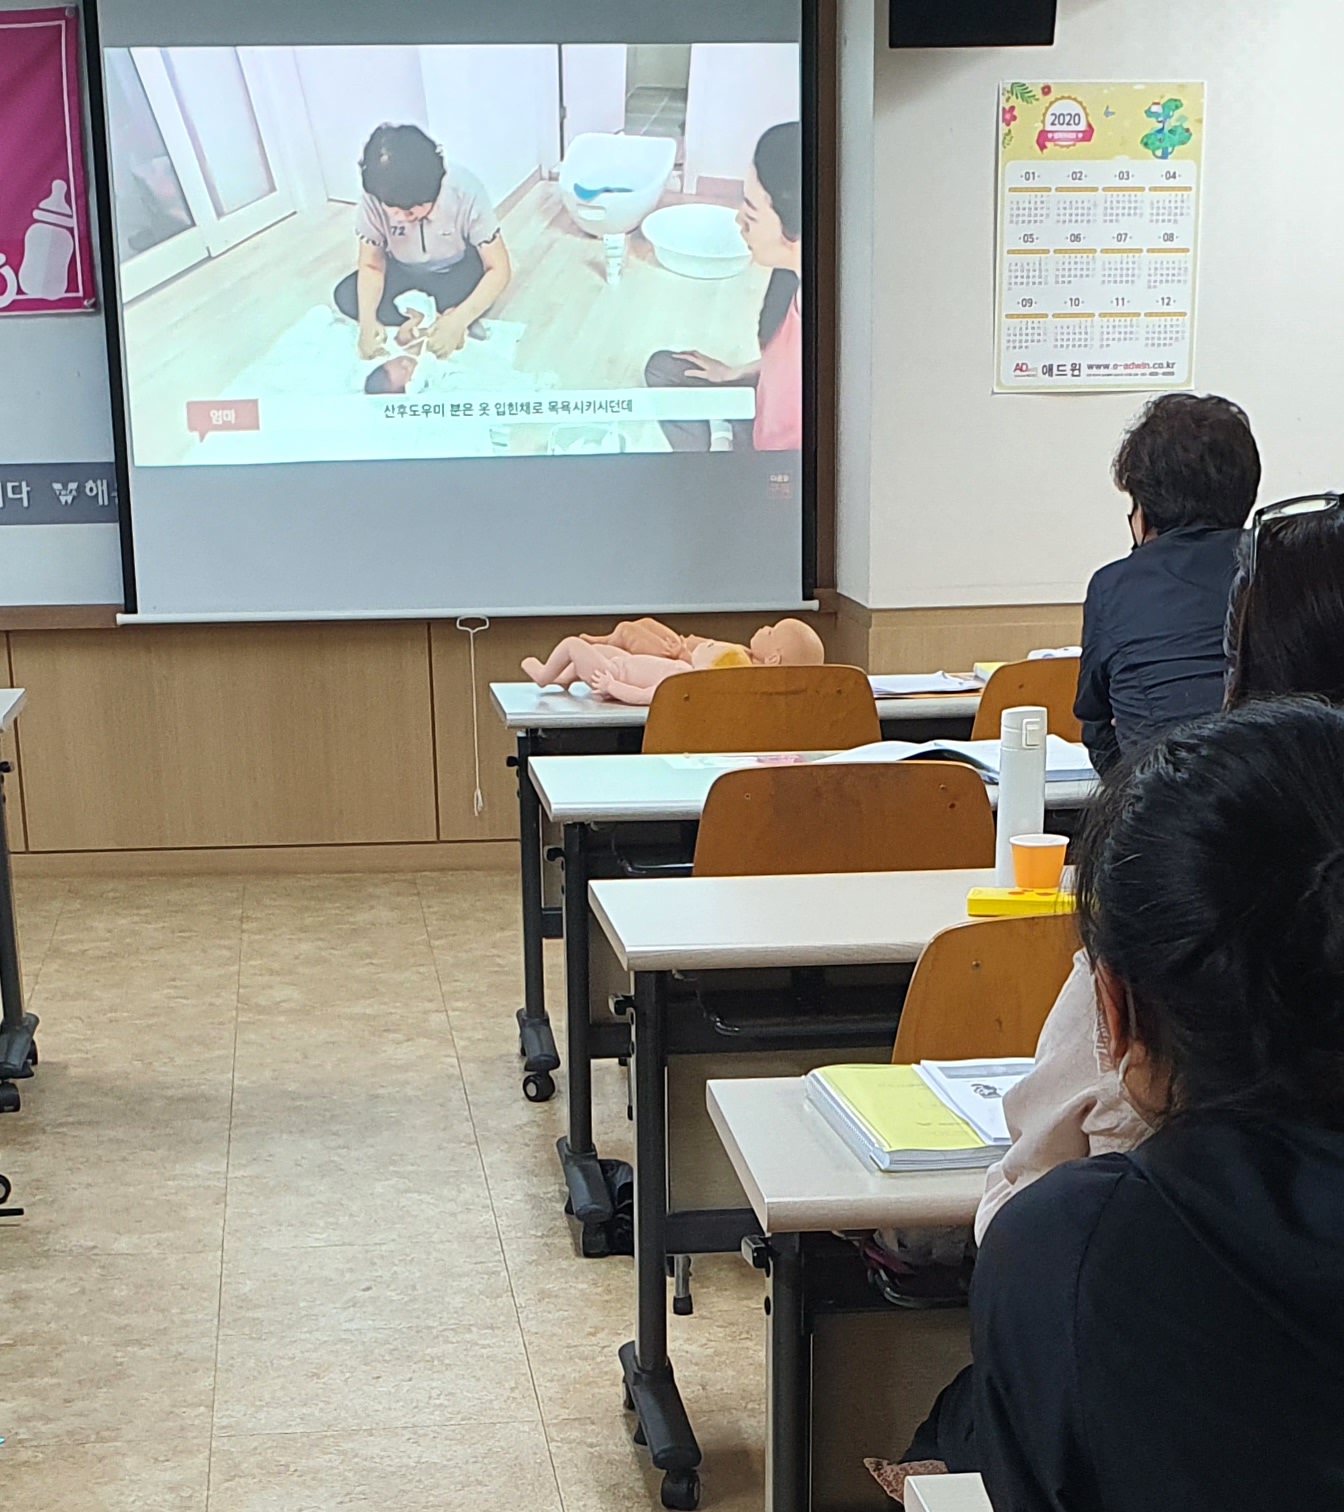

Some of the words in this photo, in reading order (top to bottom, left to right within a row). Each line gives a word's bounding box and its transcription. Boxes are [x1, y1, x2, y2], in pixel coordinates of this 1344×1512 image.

[1050, 112, 1082, 126] 2020
[209, 407, 236, 425] 엄마
[384, 403, 445, 419] 산후도우미
[450, 403, 474, 417] 분은
[479, 402, 490, 417] 옷
[495, 401, 543, 416] 입힌채로
[548, 399, 633, 415] 목욕시키시던데
[85, 479, 117, 506] 해
